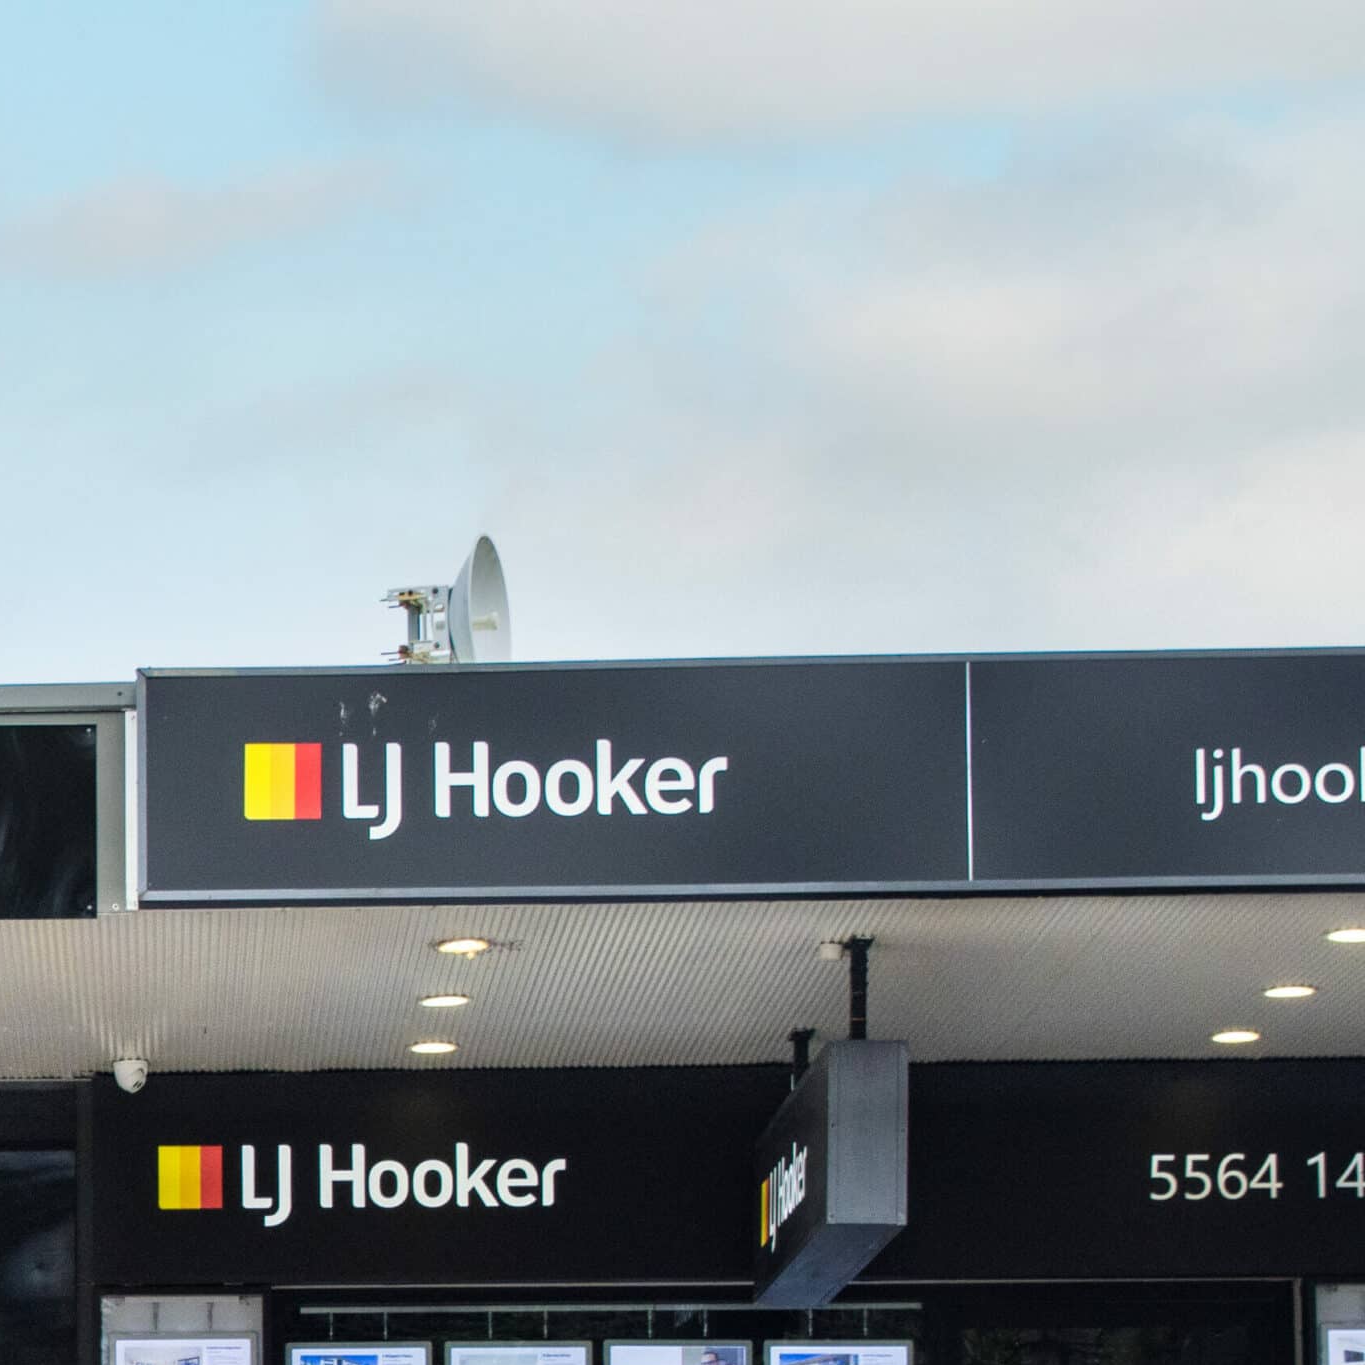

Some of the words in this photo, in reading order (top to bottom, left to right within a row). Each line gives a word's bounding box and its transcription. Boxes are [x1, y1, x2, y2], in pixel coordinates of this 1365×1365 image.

[342, 742, 402, 840] LJ
[434, 738, 729, 818] Hooker
[1195, 746, 1365, 821] ljhoo
[241, 1144, 292, 1227] LJ
[319, 1142, 566, 1209] Hooker
[1150, 1152, 1283, 1201] 5564
[1307, 1151, 1365, 1199] 14
